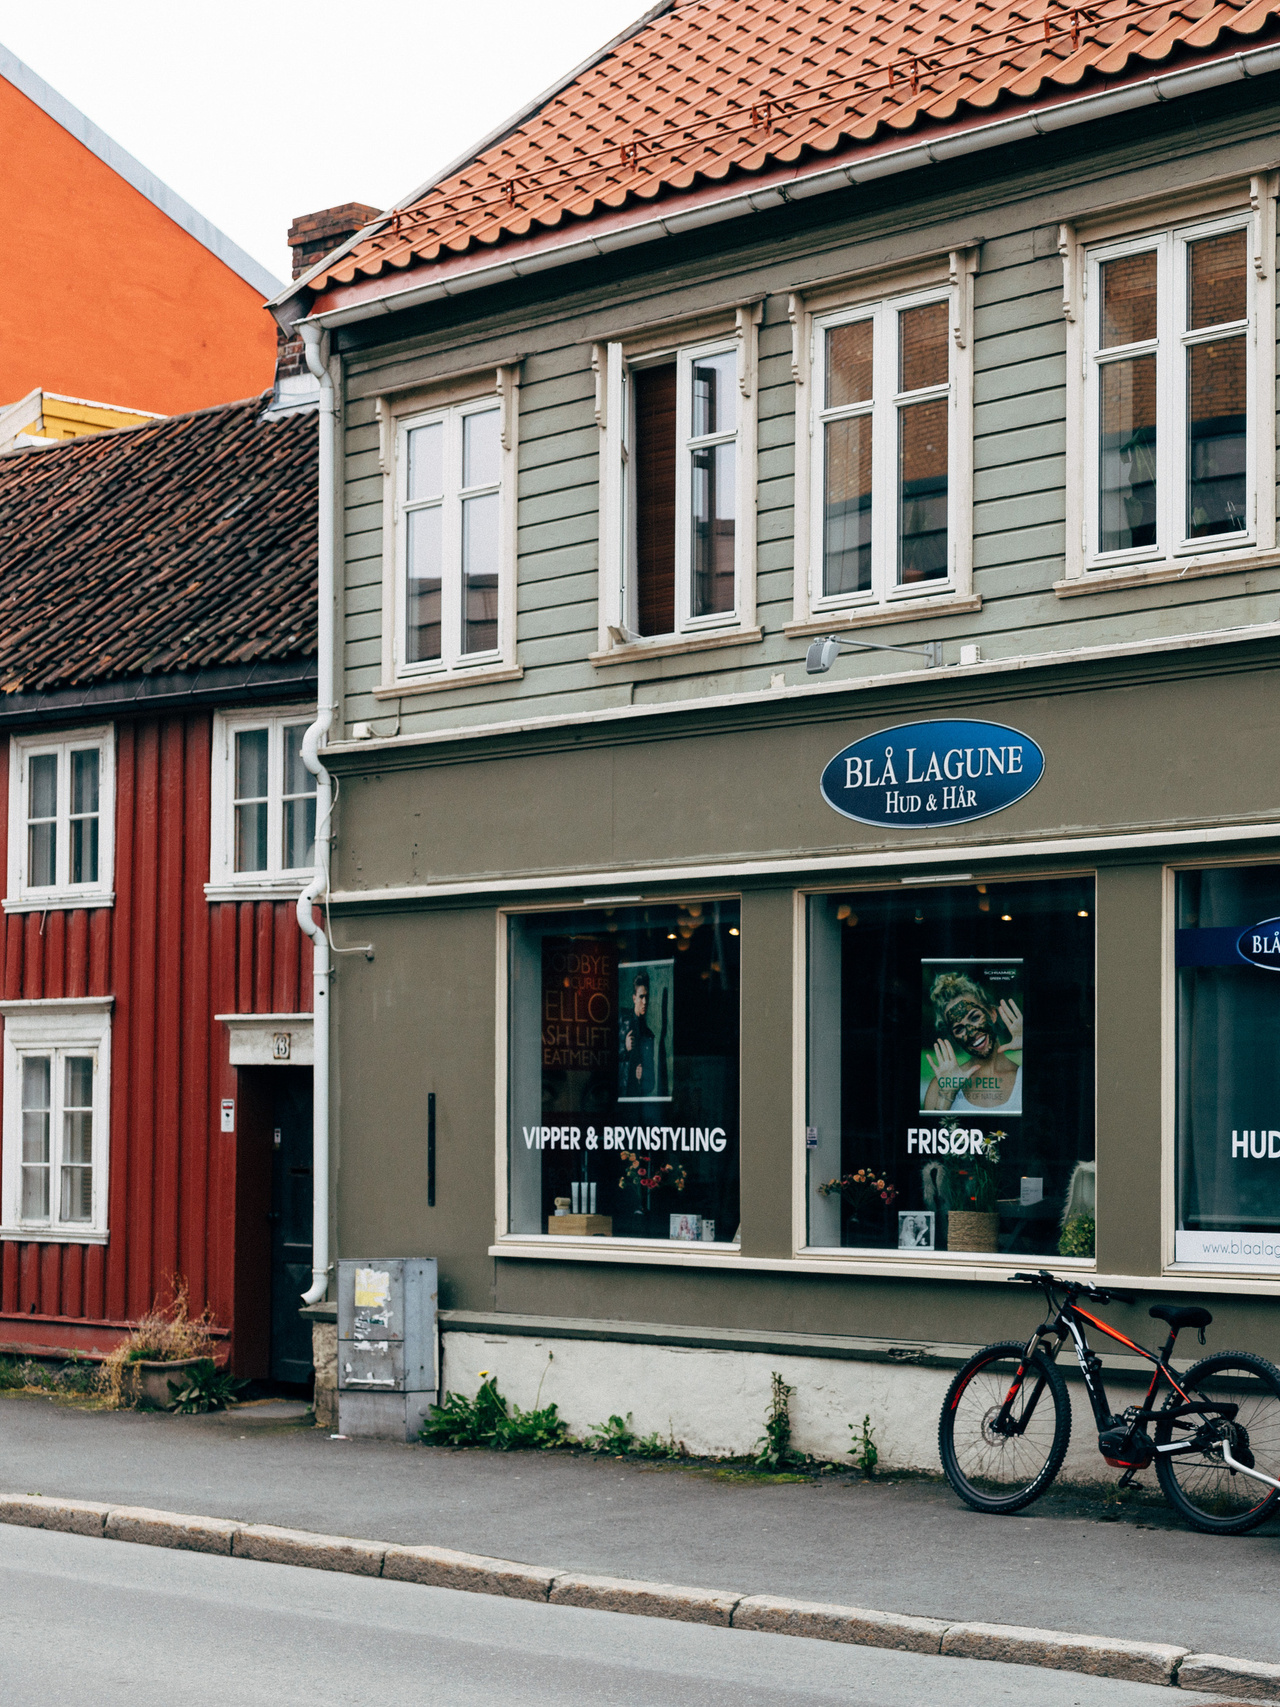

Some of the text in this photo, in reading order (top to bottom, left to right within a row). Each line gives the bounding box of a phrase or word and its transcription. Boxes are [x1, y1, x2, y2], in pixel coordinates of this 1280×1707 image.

[844, 746, 1023, 788] BLÅ LAGUNE
[885, 785, 977, 813] HUD & HÅR
[545, 990, 611, 1023] ELLO
[576, 1026, 611, 1048] LIFT
[938, 1076, 972, 1089] GREEN
[522, 1126, 728, 1153] VIPPER & BRYNSTYLING
[907, 1128, 983, 1155] FRISØR
